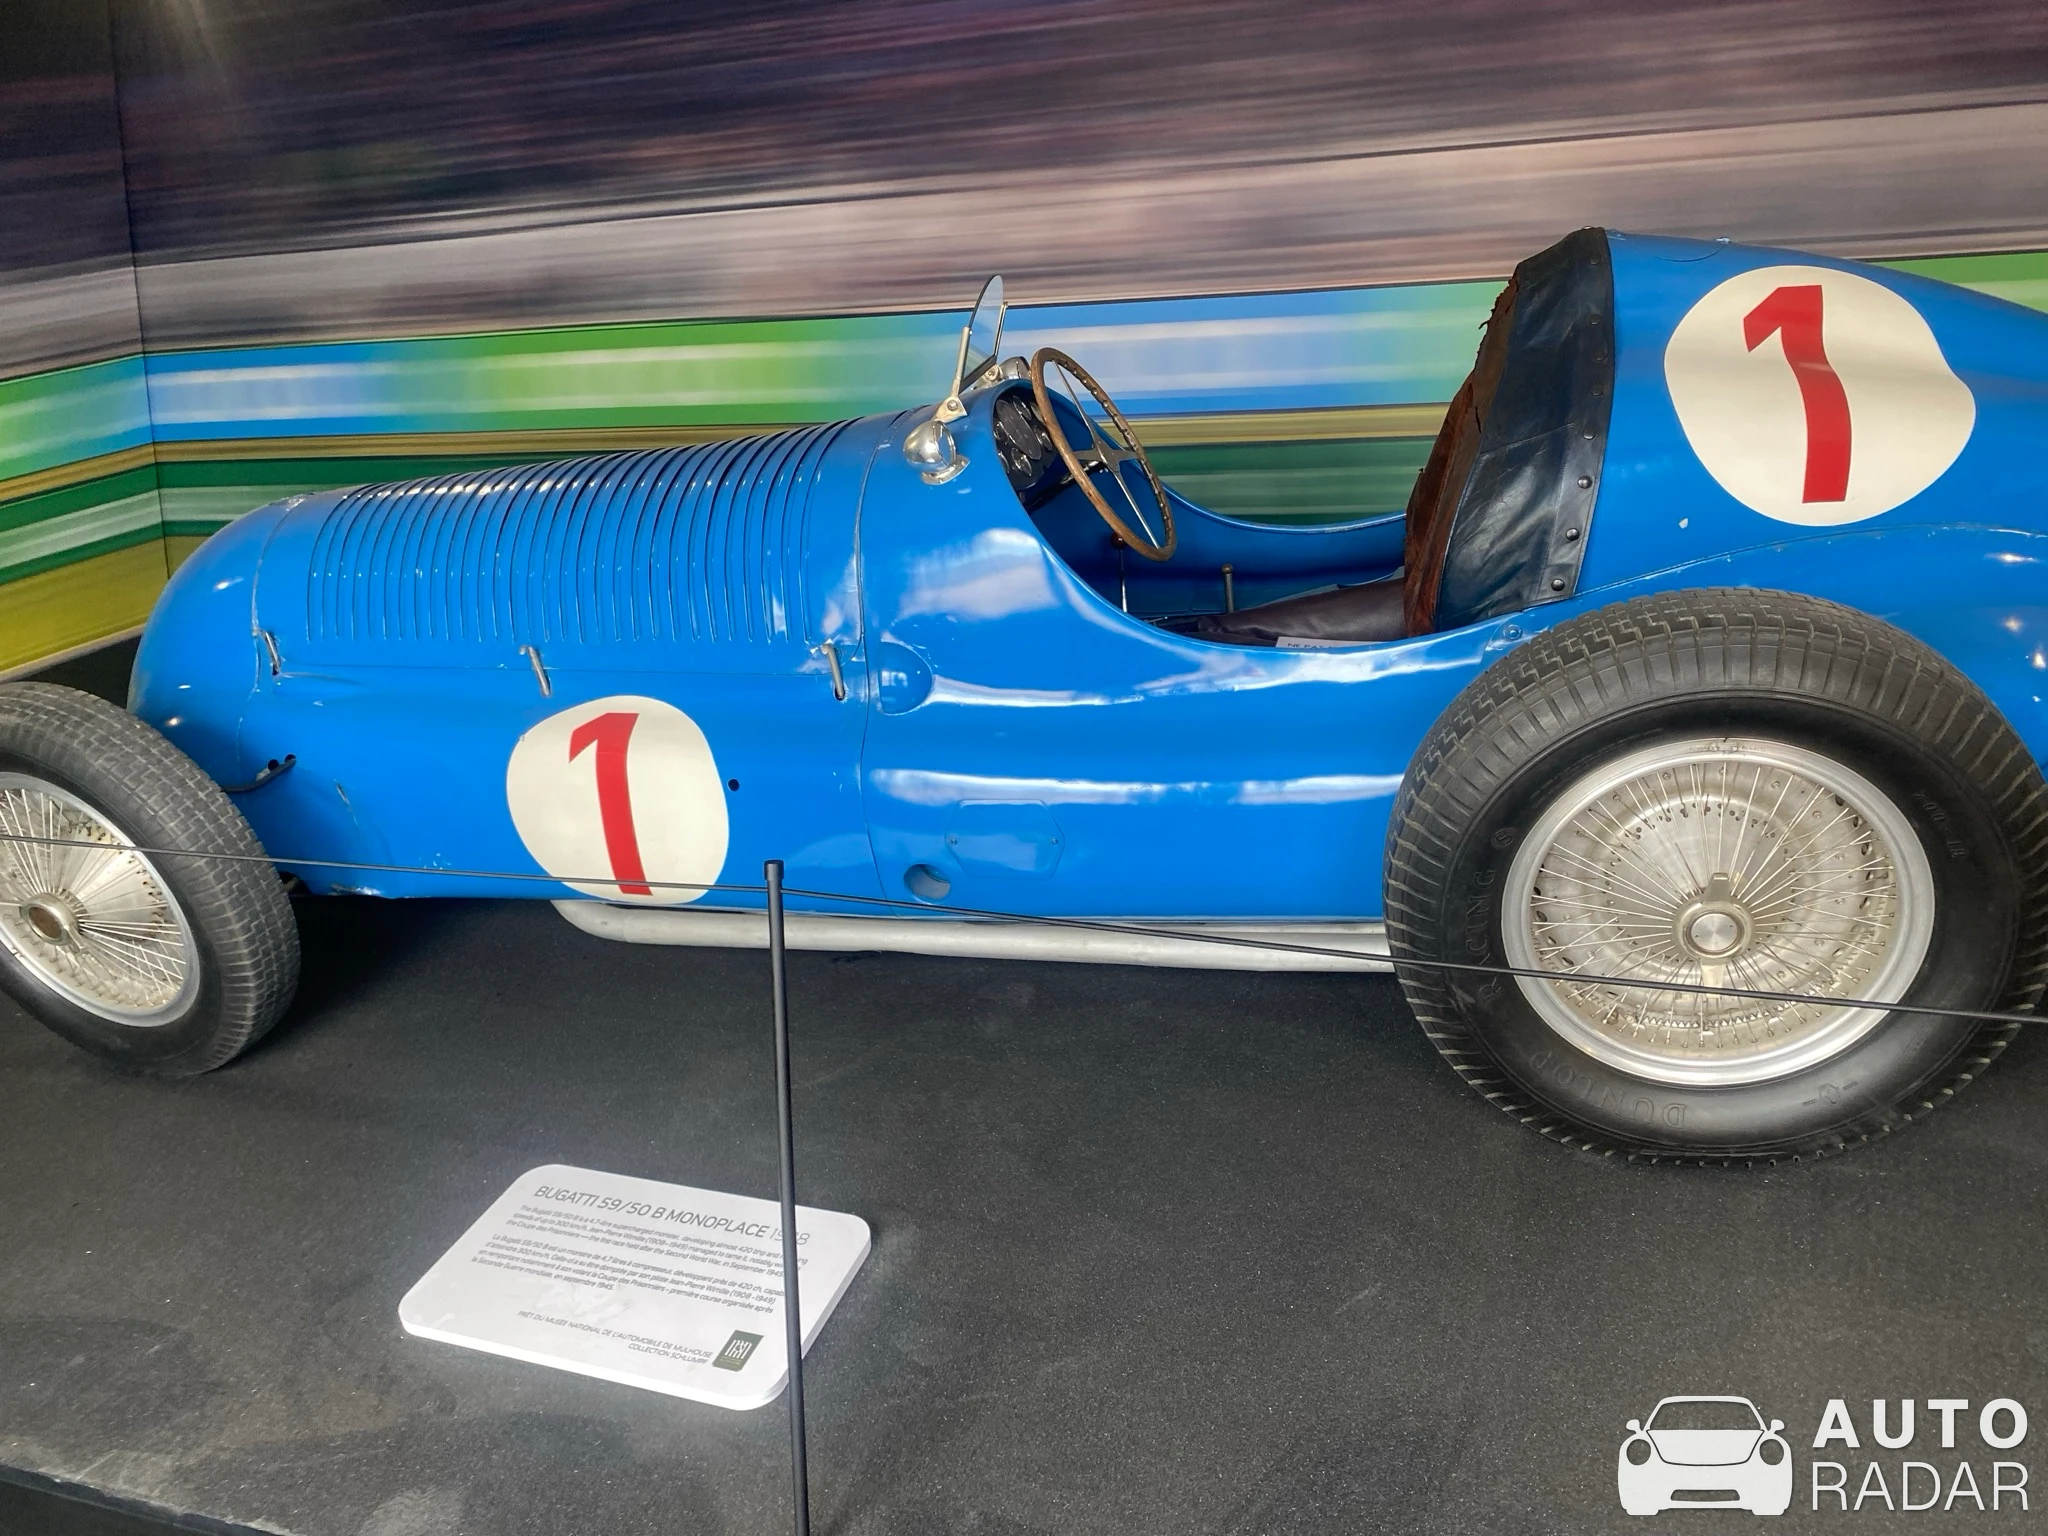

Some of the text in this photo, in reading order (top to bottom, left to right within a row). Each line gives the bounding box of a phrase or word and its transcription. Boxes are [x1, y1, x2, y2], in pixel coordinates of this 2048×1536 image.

[1743, 284, 1852, 504] 1
[568, 712, 653, 896] 1
[1529, 1051, 1688, 1130] DUNLOP
[533, 1186, 812, 1245] BUGATTI 59/50 B MONOPLACE 198
